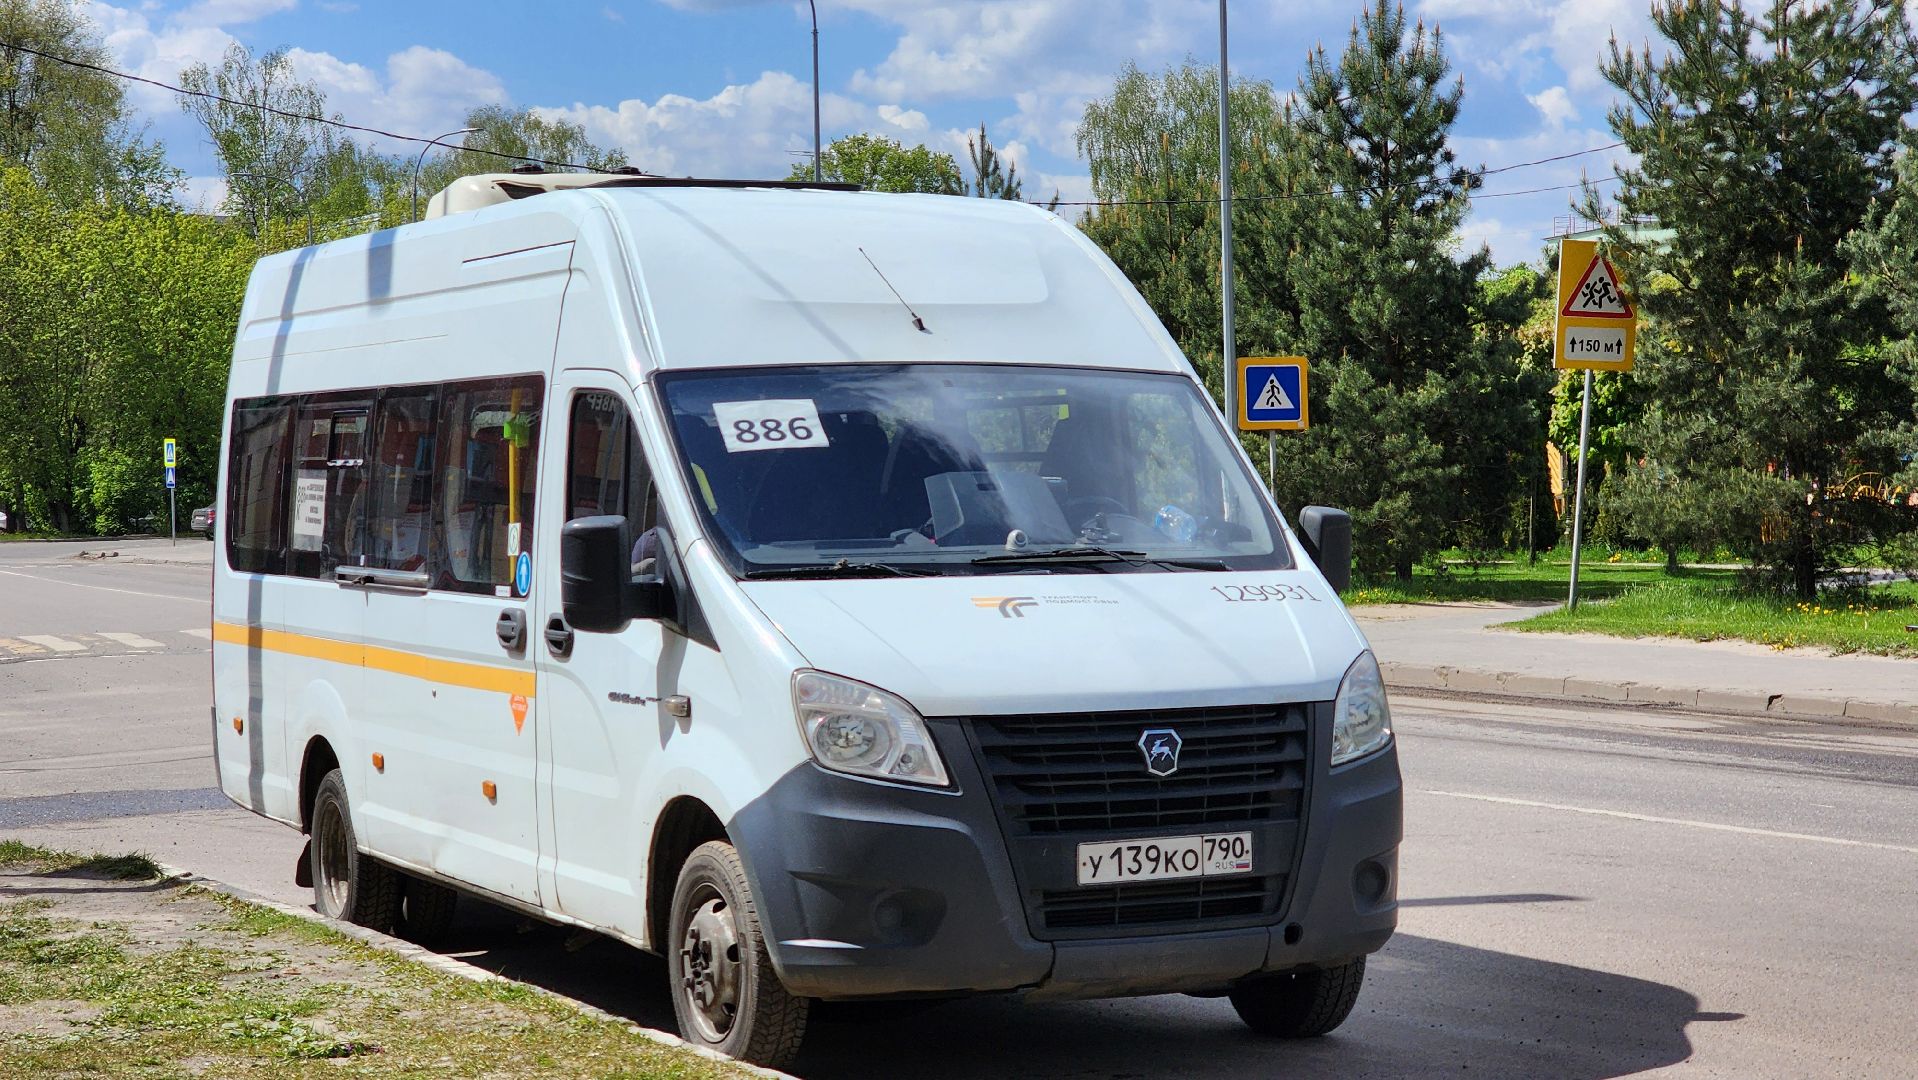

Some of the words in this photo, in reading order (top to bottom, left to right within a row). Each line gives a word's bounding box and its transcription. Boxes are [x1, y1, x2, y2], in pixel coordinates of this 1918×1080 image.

[1578, 339, 1600, 353] 150
[733, 416, 813, 443] 886
[1210, 584, 1322, 602] 129931
[1204, 837, 1245, 861] 790
[1215, 859, 1234, 870] RUS
